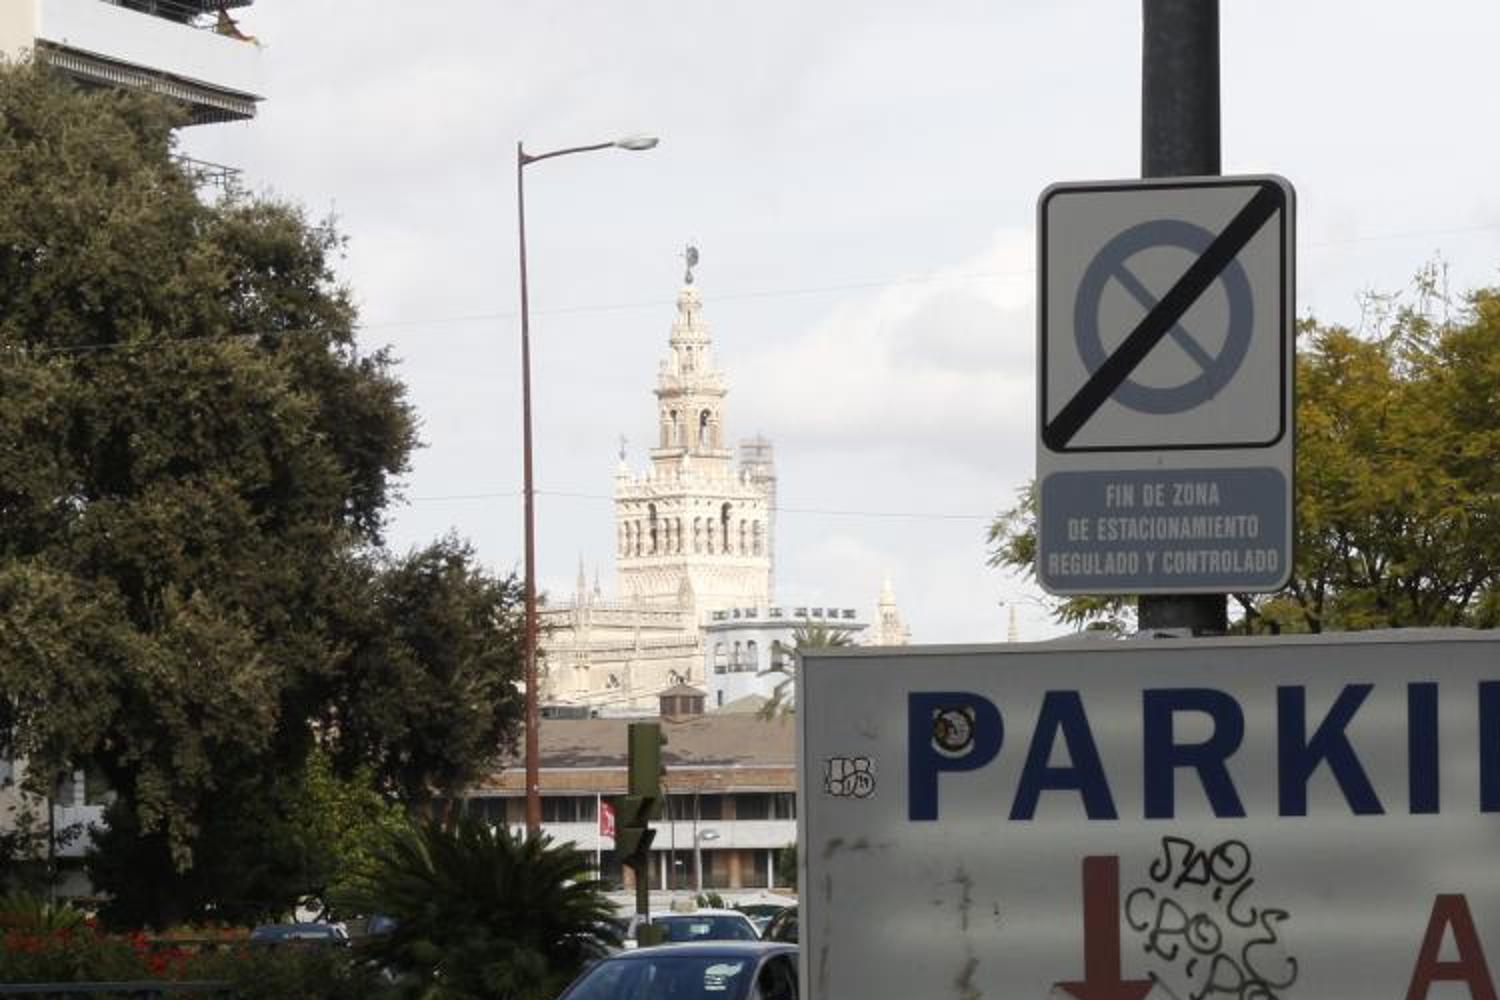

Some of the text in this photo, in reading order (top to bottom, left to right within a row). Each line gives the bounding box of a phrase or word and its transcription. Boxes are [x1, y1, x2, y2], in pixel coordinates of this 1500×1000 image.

[1106, 481, 1220, 508] FIN DE ZONA
[1068, 514, 1260, 542] DE ESTACIONAMIENTO
[1048, 548, 1279, 577] REGULADO Y CONTROLADO
